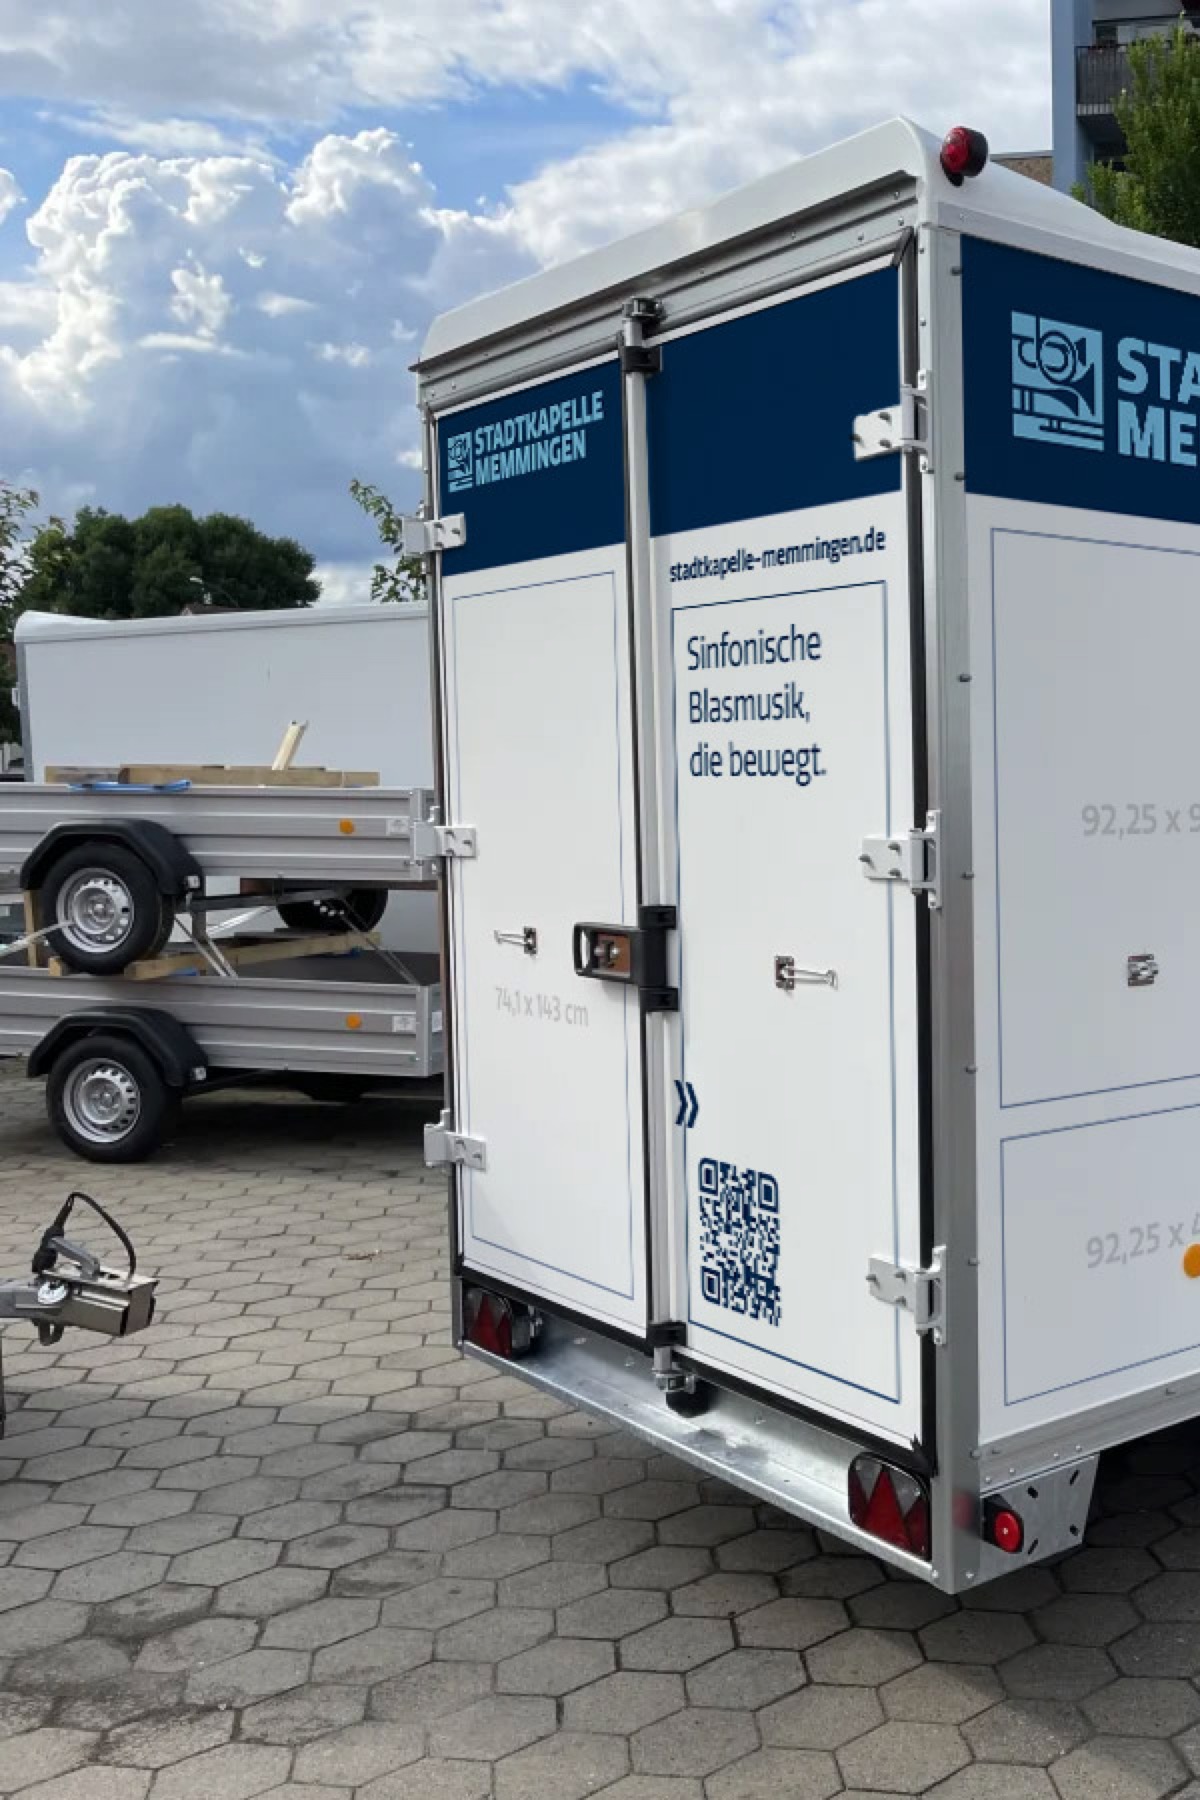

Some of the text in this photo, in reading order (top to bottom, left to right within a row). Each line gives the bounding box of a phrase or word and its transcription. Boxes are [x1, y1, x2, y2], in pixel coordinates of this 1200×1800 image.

[475, 391, 604, 456] STADTKAPELLE
[475, 430, 587, 487] MEMMINGEN
[669, 527, 886, 582] stadtkapelle-memmingen.de
[687, 623, 822, 670] Sinfonische
[689, 682, 811, 724] Blasmusik,
[689, 741, 827, 786] die bewegt.
[1081, 803, 1157, 840] 92,25
[1165, 809, 1182, 833] x
[536, 991, 561, 1023] 143
[565, 1002, 590, 1027] cm
[1086, 1222, 1160, 1268] 92,25
[1168, 1222, 1184, 1249] x
